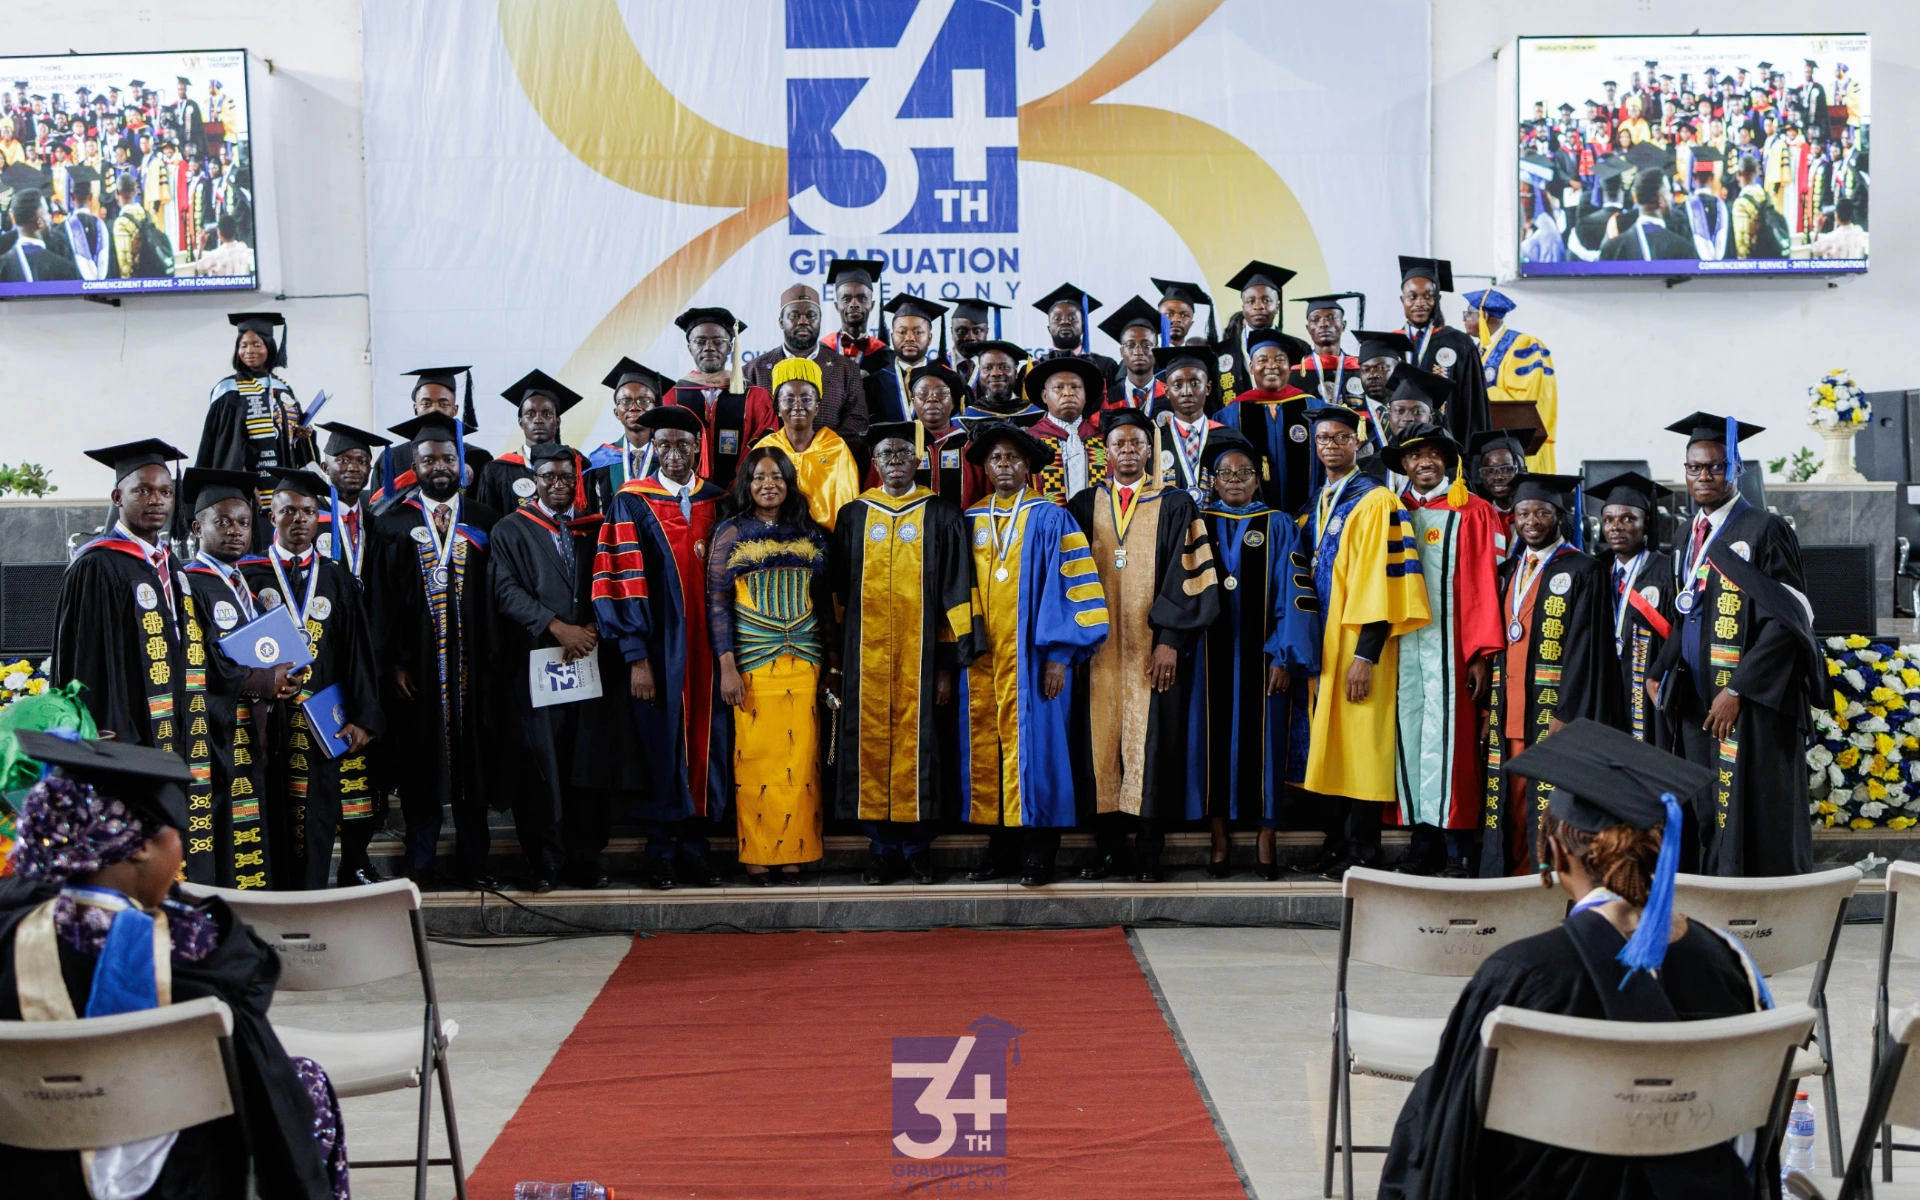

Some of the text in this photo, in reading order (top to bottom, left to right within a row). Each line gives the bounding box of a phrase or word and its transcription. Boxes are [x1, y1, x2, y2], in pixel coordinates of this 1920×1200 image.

[786, 0, 1018, 237] 34
[934, 189, 988, 223] TH
[789, 247, 1019, 275] GRADUATION
[1698, 261, 1757, 270] COMMENCEMENT
[1758, 261, 1788, 269] SERVICE
[1792, 260, 1809, 269] 34TH
[1810, 260, 1865, 269] CONGREGATION
[82, 280, 142, 290] COMMENCEMENT
[143, 280, 173, 288] SERVICE
[178, 279, 195, 287] 34TH
[196, 277, 251, 286] CONGREGATION
[793, 281, 1021, 301] EEMONY
